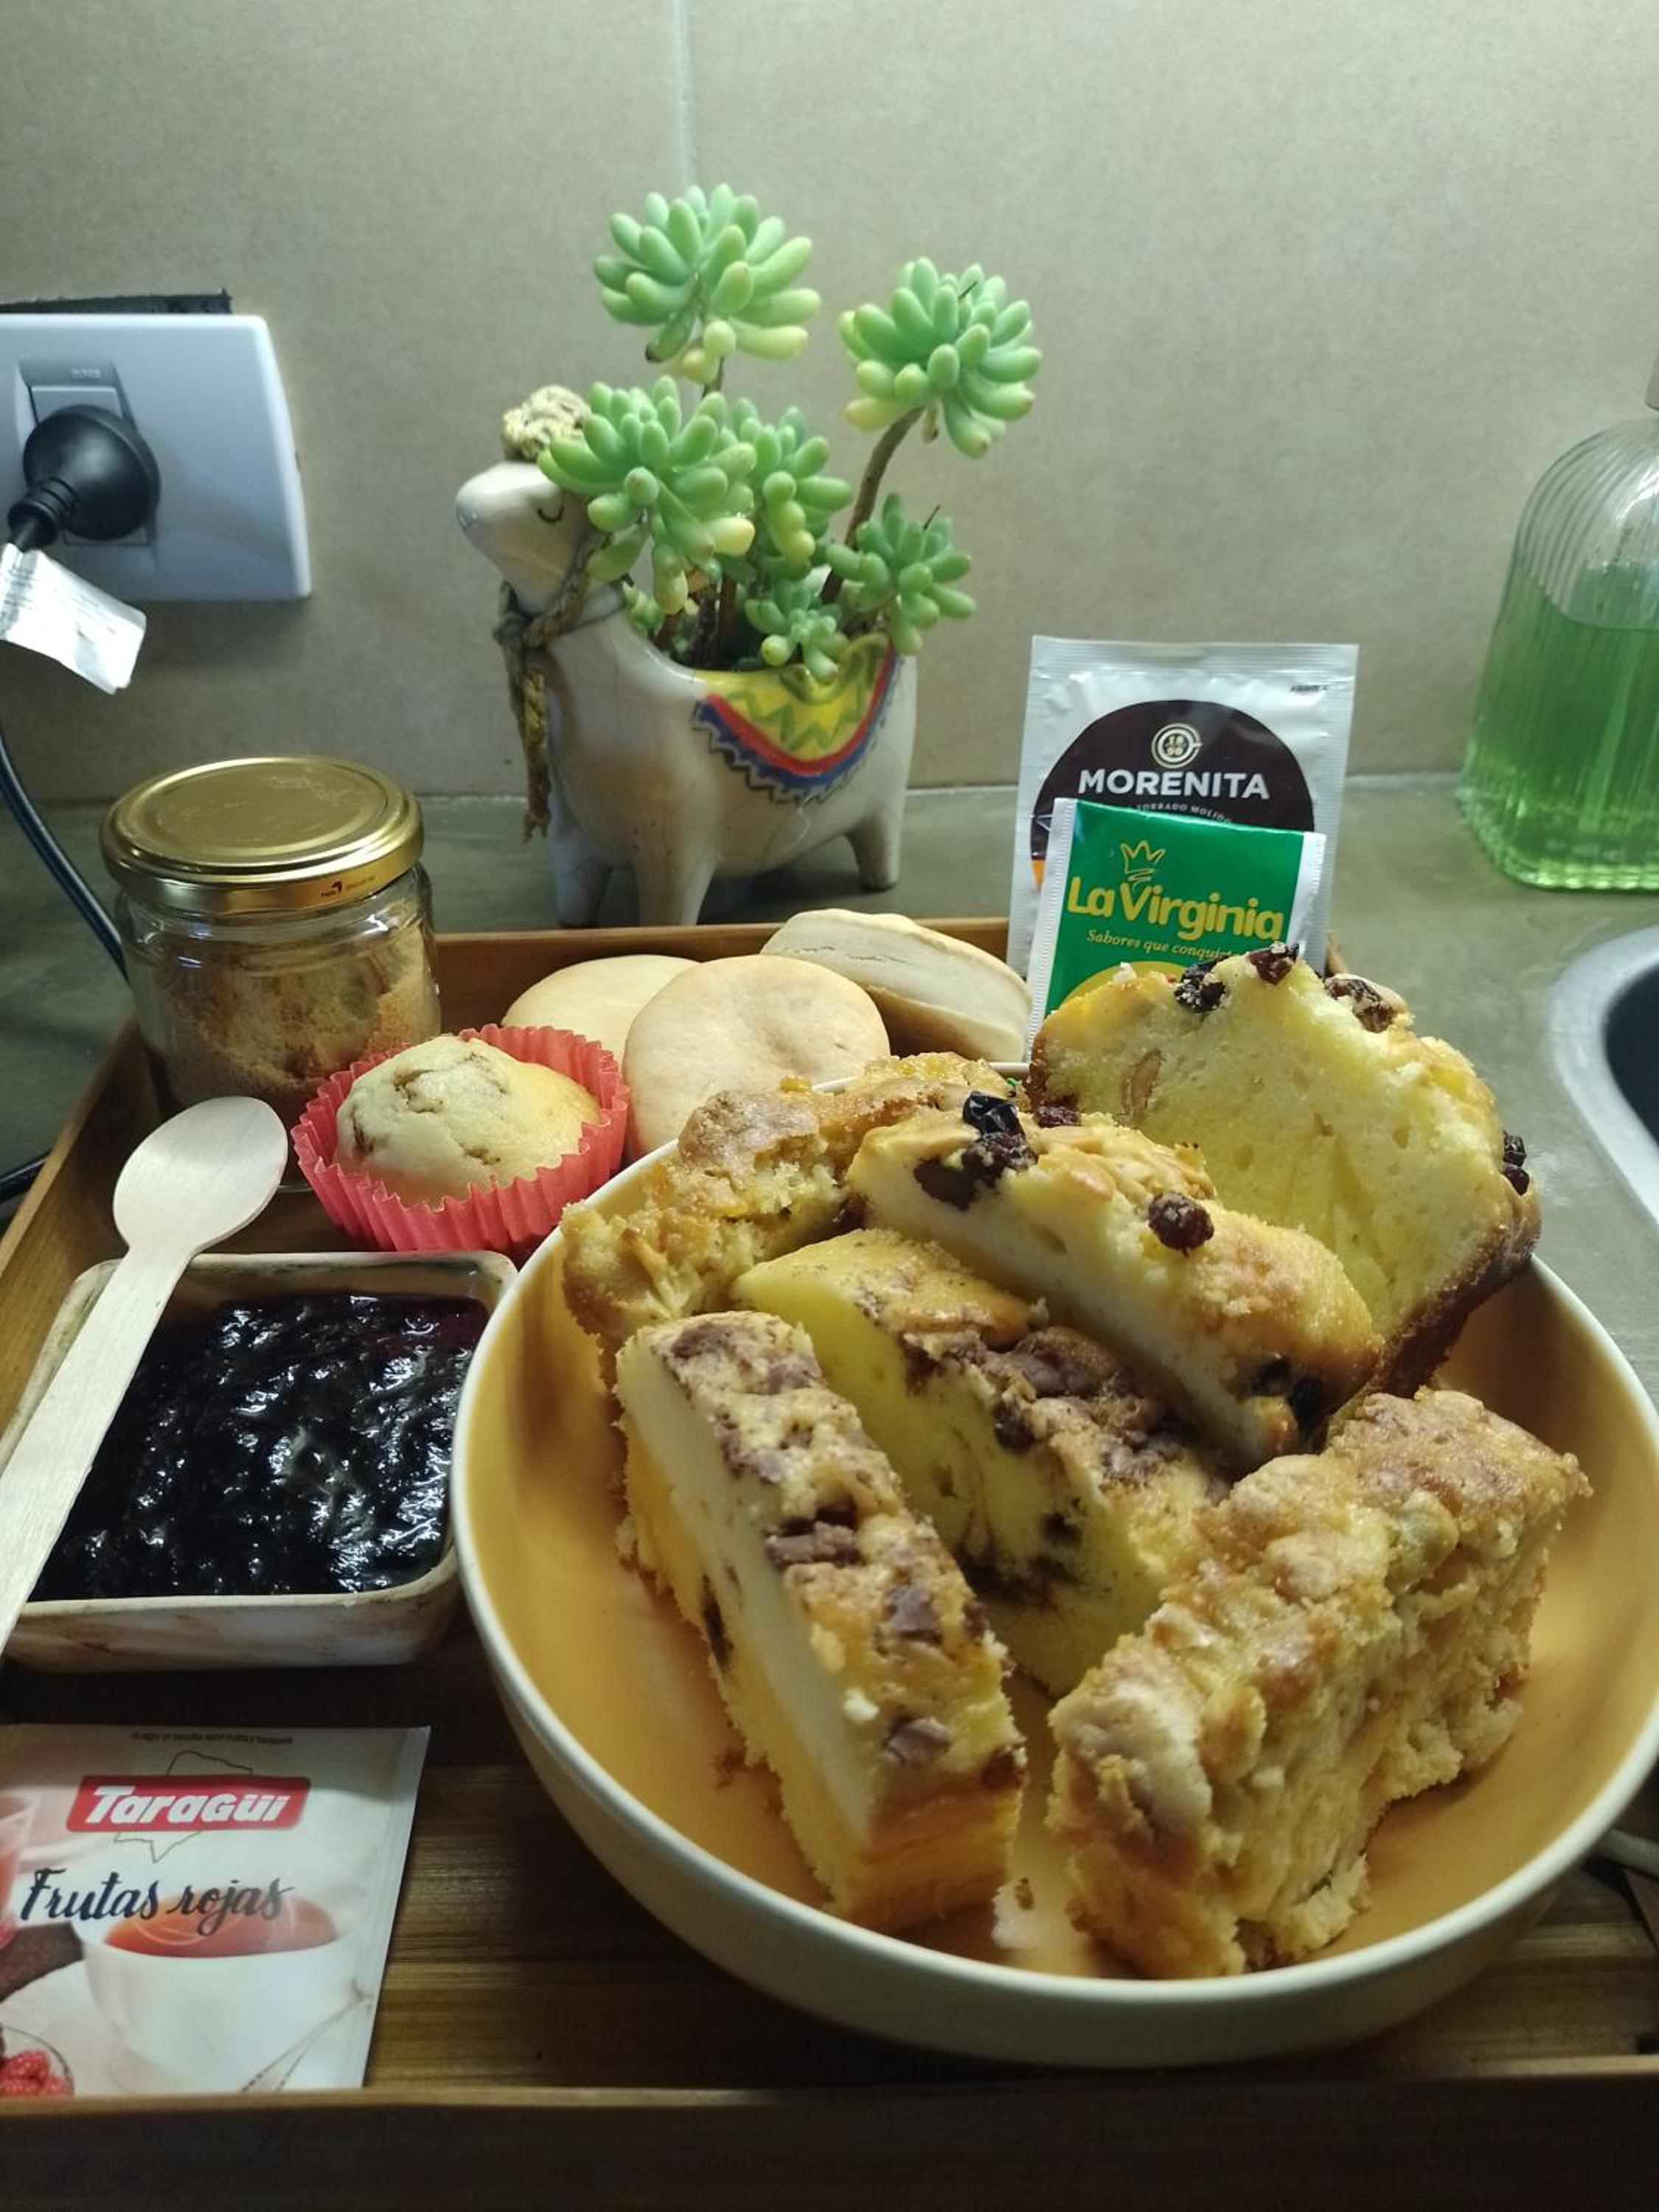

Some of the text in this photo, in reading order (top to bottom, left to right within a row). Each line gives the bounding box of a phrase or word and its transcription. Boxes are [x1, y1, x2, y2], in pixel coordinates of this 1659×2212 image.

[1077, 768, 1270, 800] MORENITA
[1087, 930, 1139, 947] Sabores
[1144, 941, 1169, 953] que
[21, 1868, 295, 1936] Frutas rojas
